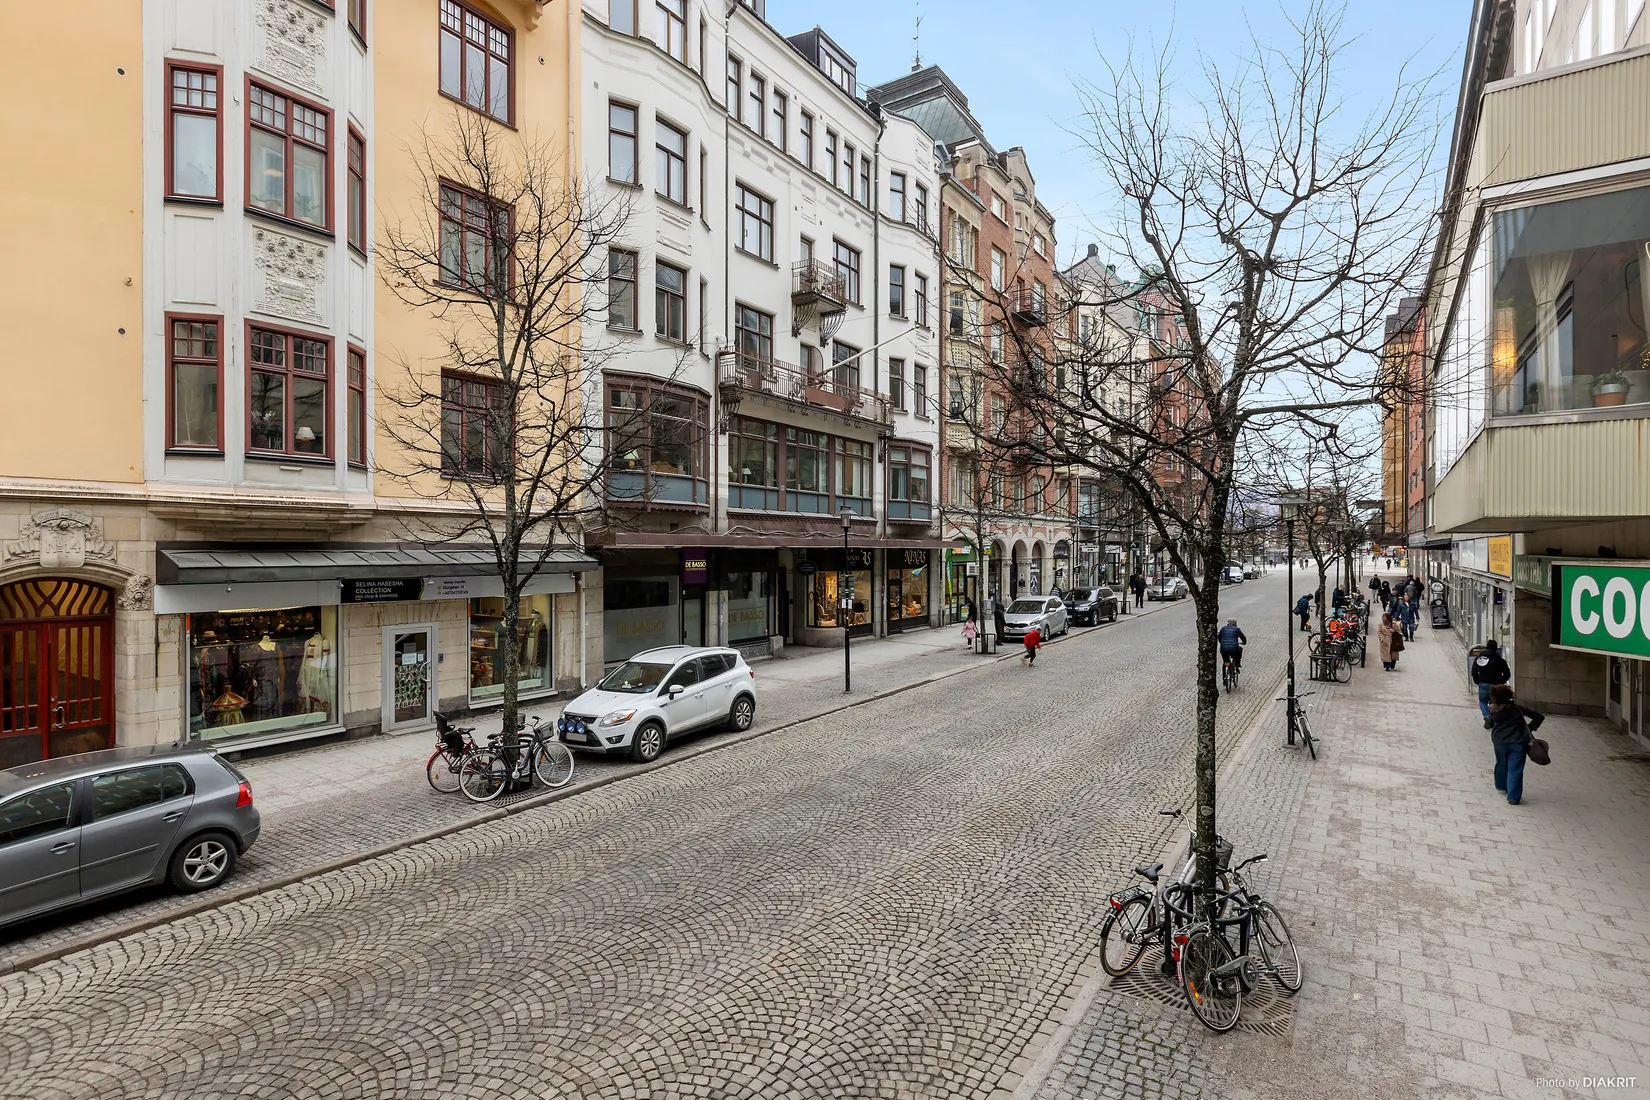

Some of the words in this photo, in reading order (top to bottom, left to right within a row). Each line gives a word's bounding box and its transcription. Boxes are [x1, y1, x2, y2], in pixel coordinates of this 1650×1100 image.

[904, 549, 926, 565] NINAS
[728, 611, 738, 623] DE
[740, 609, 765, 622] BASSO
[617, 621, 629, 636] DE
[632, 619, 665, 634] BASSO
